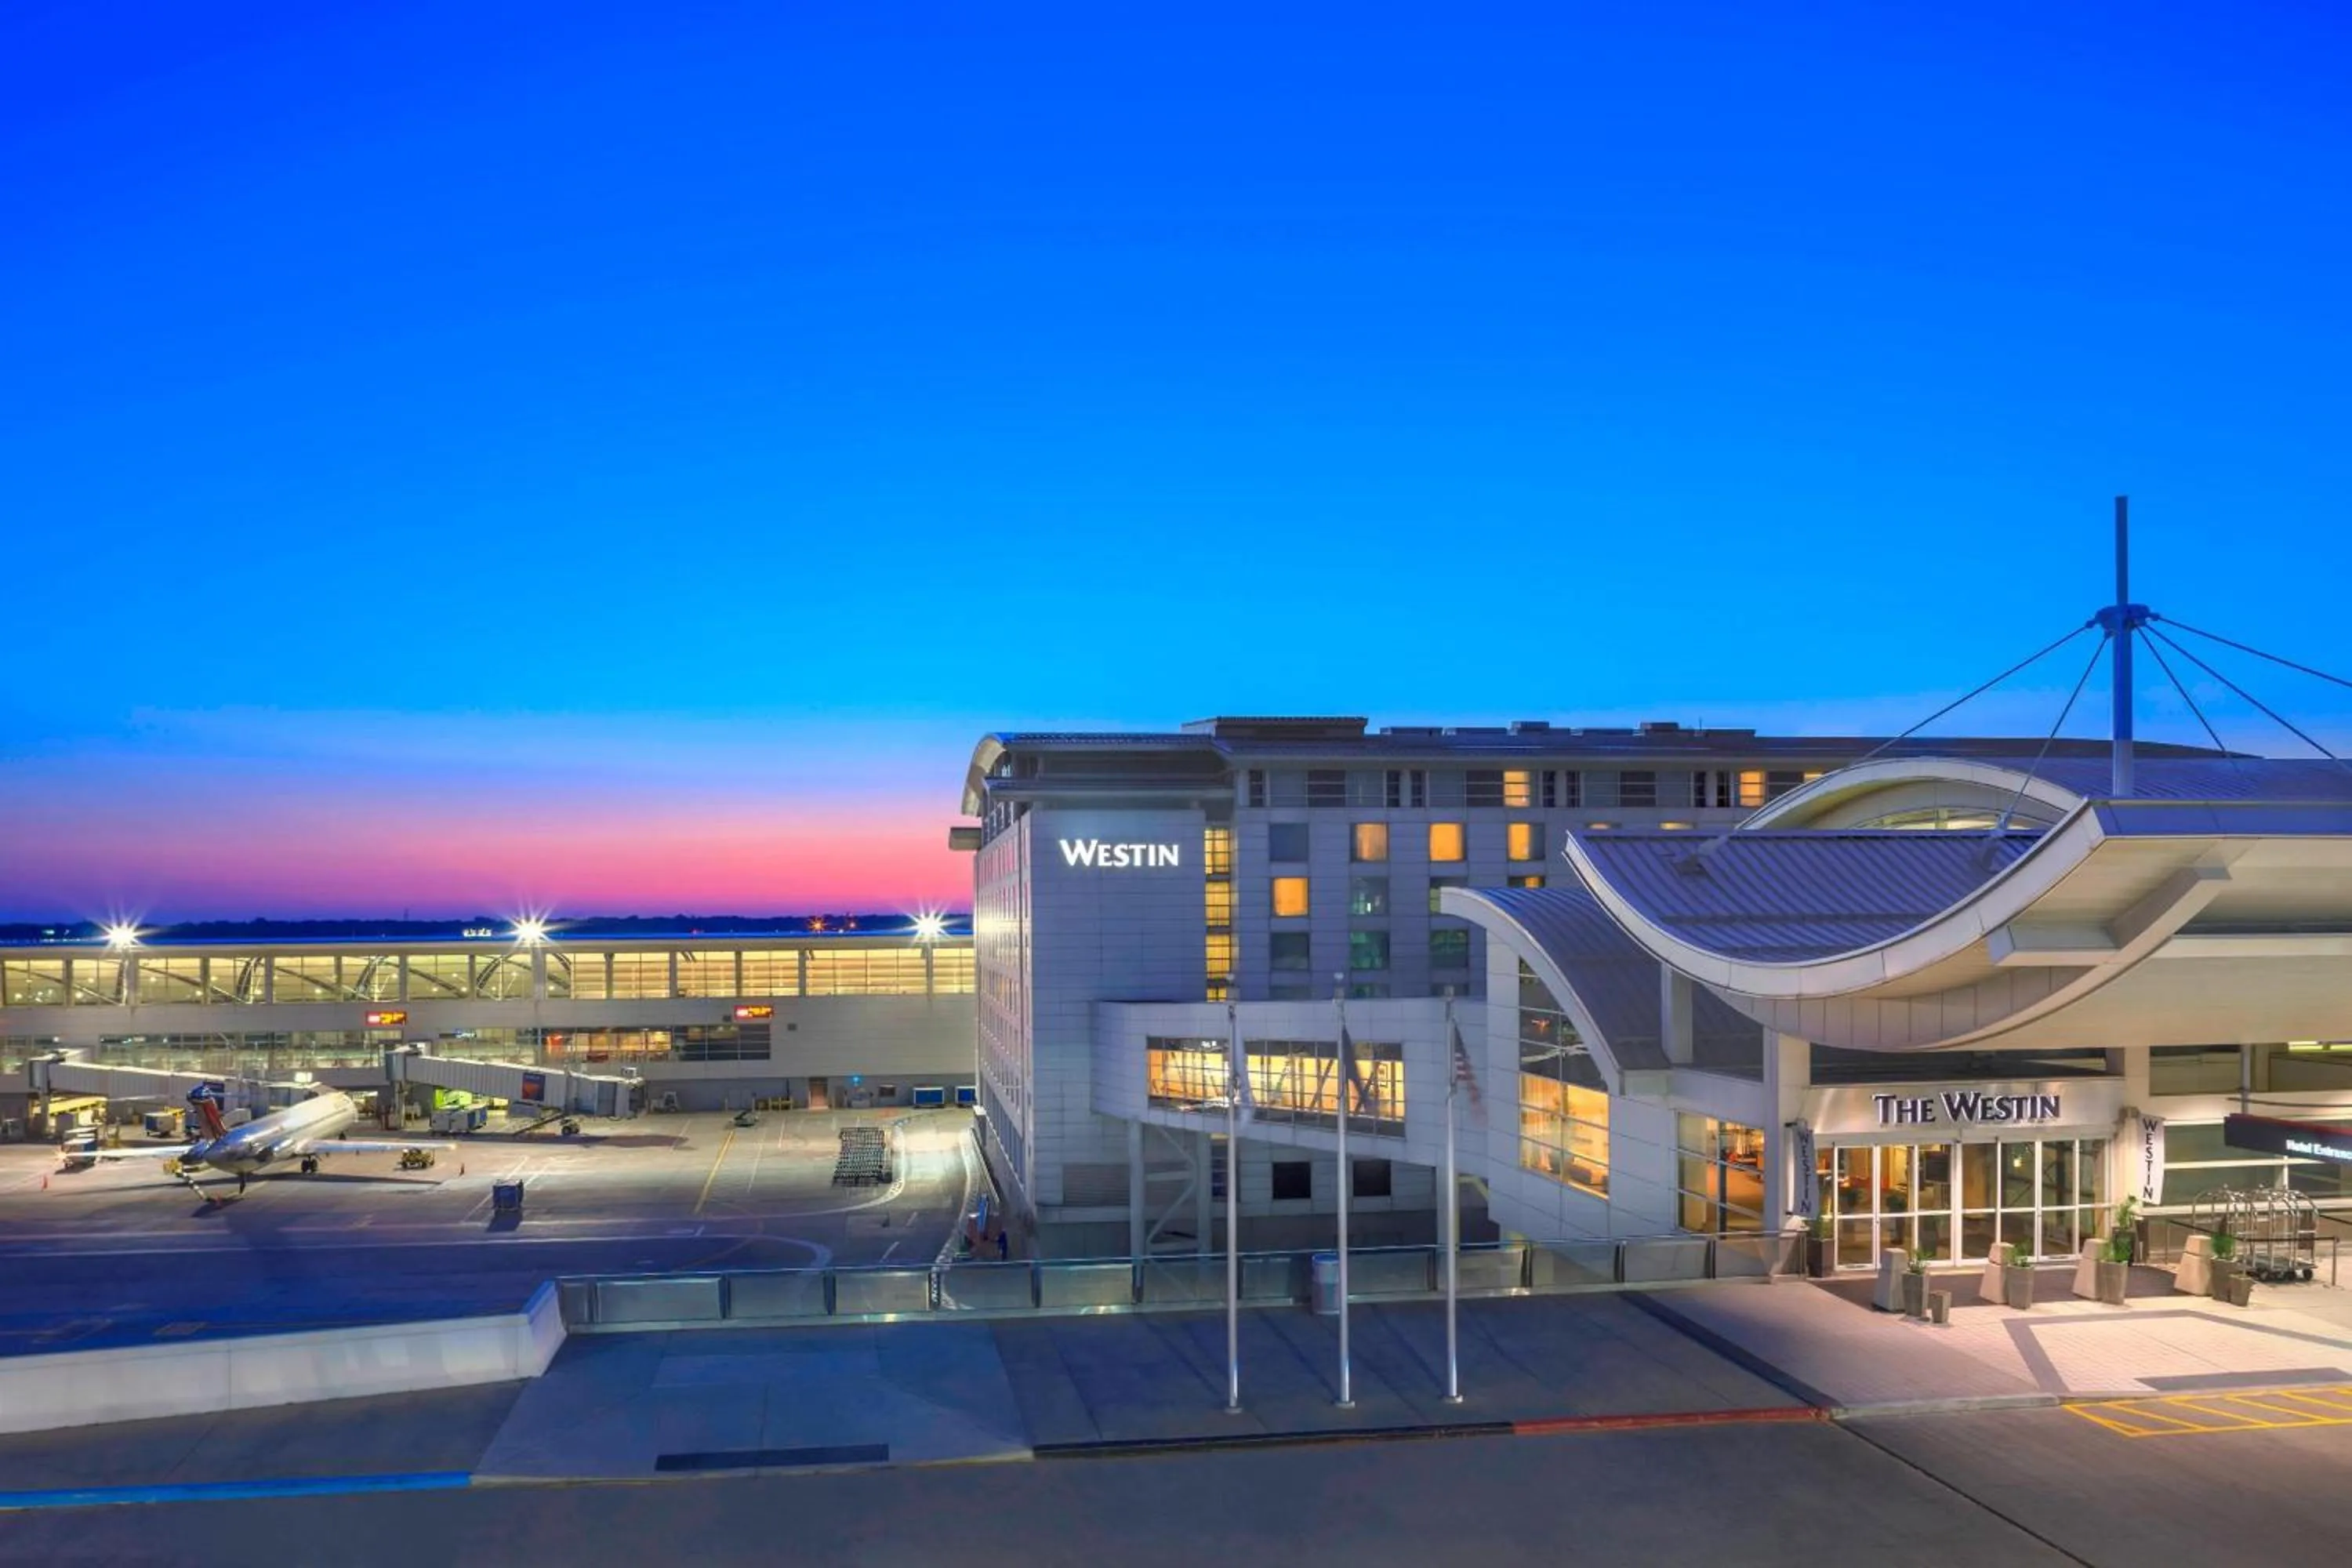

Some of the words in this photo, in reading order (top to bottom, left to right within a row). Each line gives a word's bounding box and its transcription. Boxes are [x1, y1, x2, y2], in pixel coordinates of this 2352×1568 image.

[1059, 839, 1180, 866] WESTIN
[1872, 1094, 1936, 1123] THE
[1940, 1091, 2060, 1122] WESTIN
[2142, 1117, 2158, 1200] WESTIN
